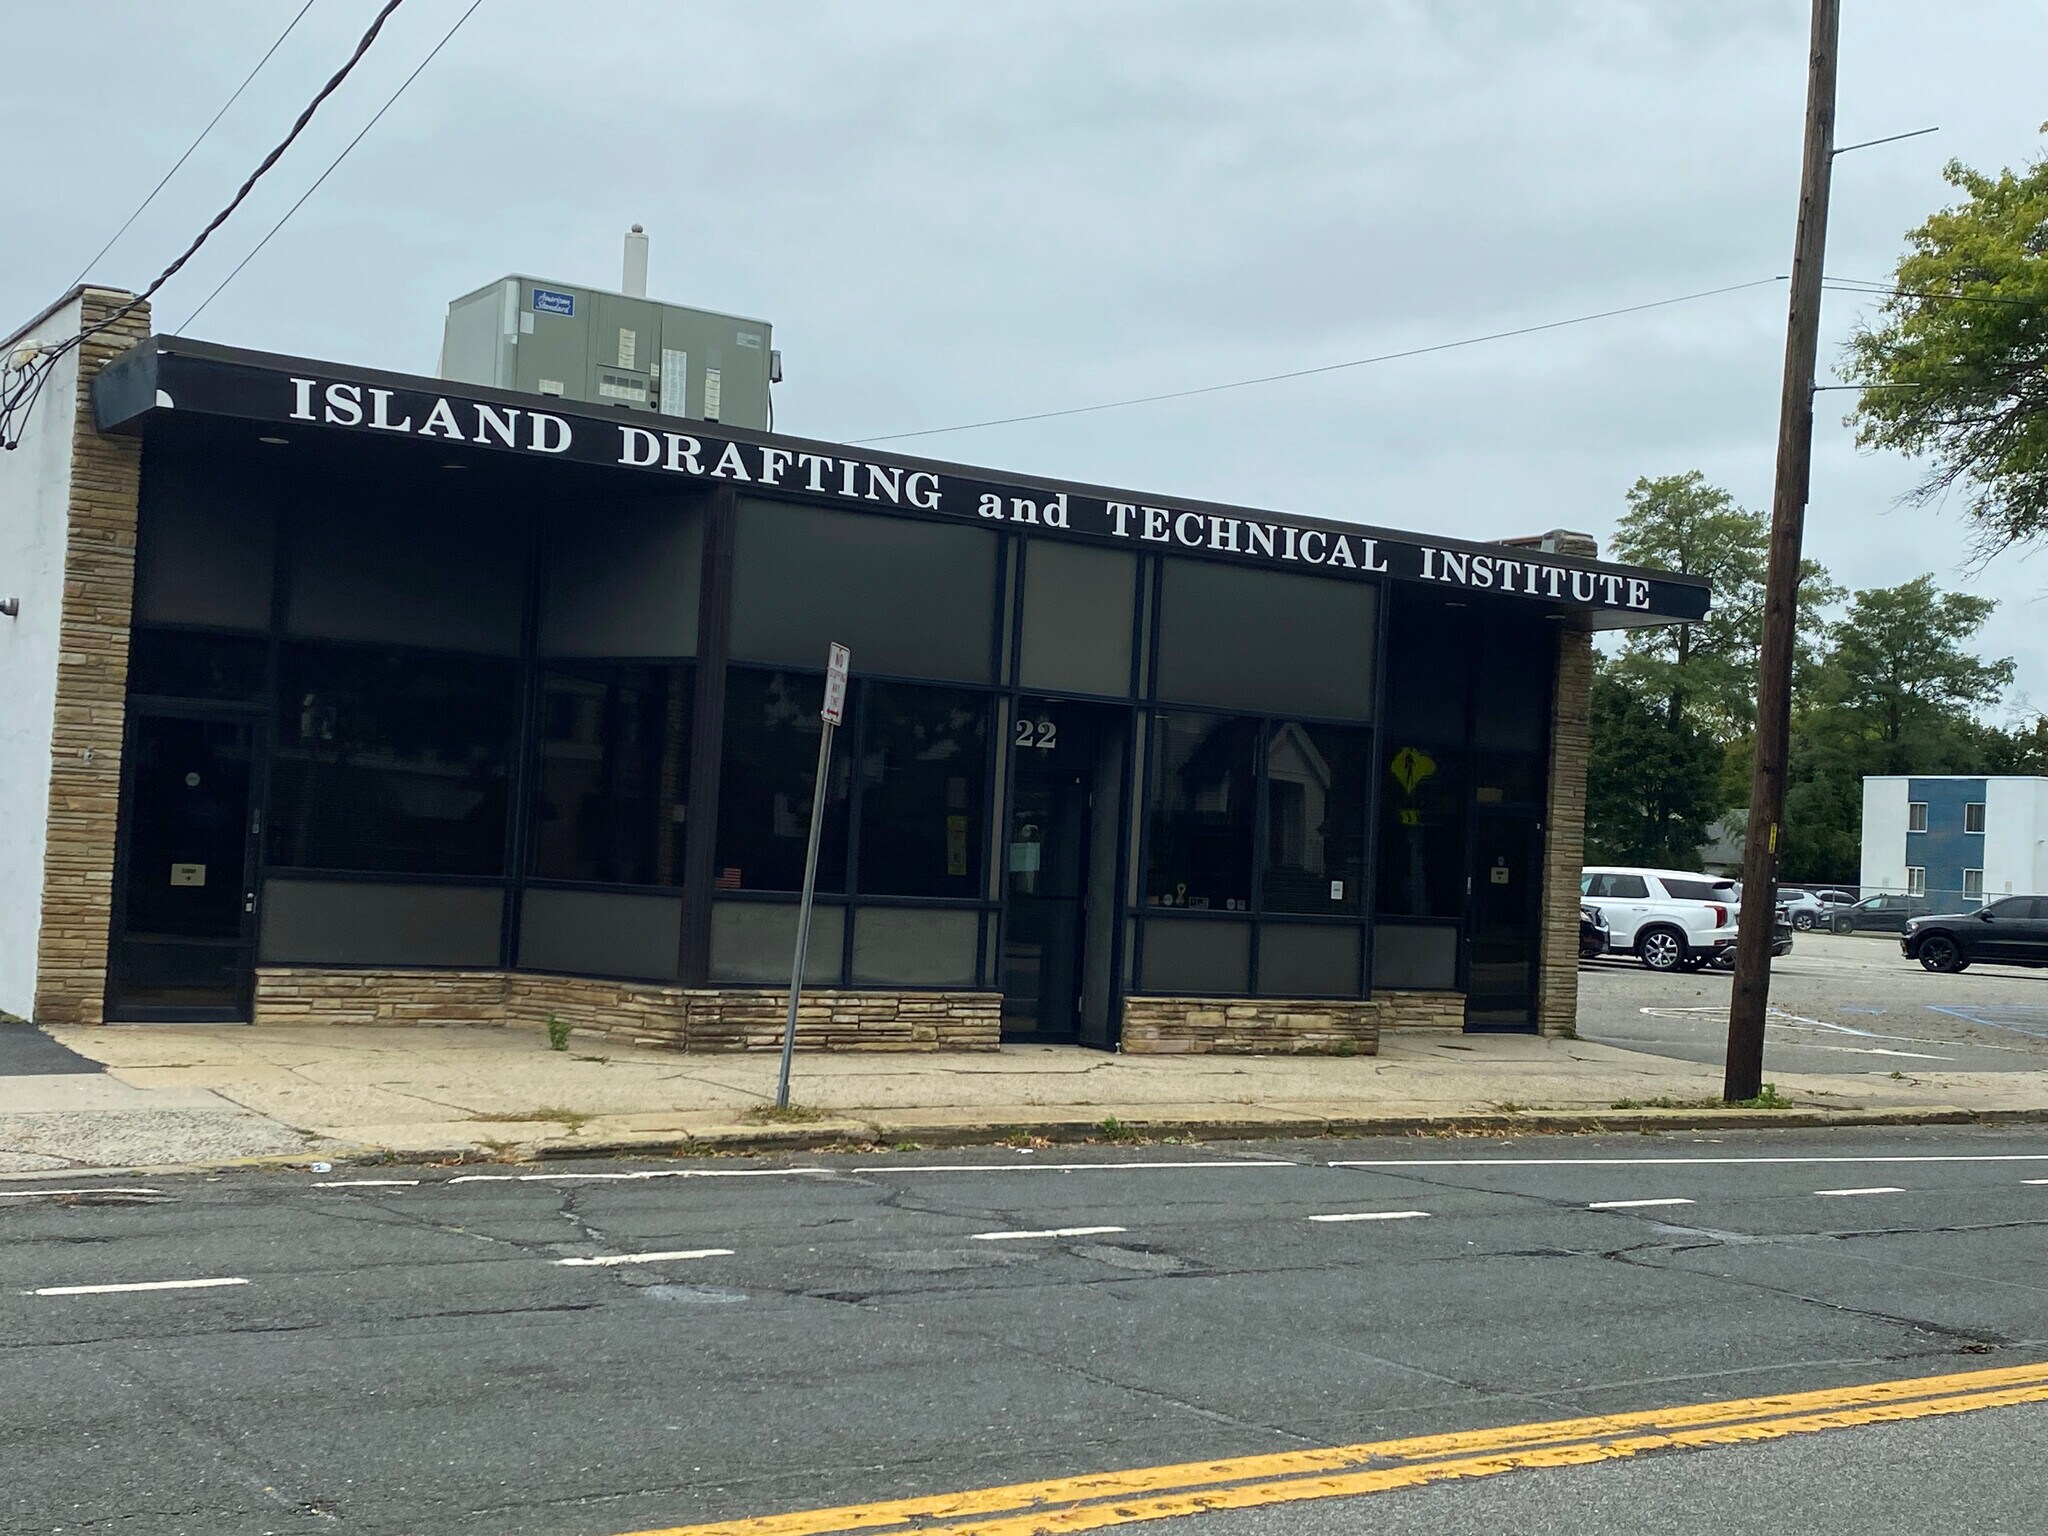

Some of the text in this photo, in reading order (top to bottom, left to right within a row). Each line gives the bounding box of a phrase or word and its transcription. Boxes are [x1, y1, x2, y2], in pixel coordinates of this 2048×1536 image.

[535, 301, 571, 313] Standard
[538, 293, 571, 305] American
[290, 378, 1650, 610] ISLAND DRAFTING and TECHNICAL INSTITUTE
[834, 652, 844, 668] NO
[1015, 719, 1056, 749] 22
